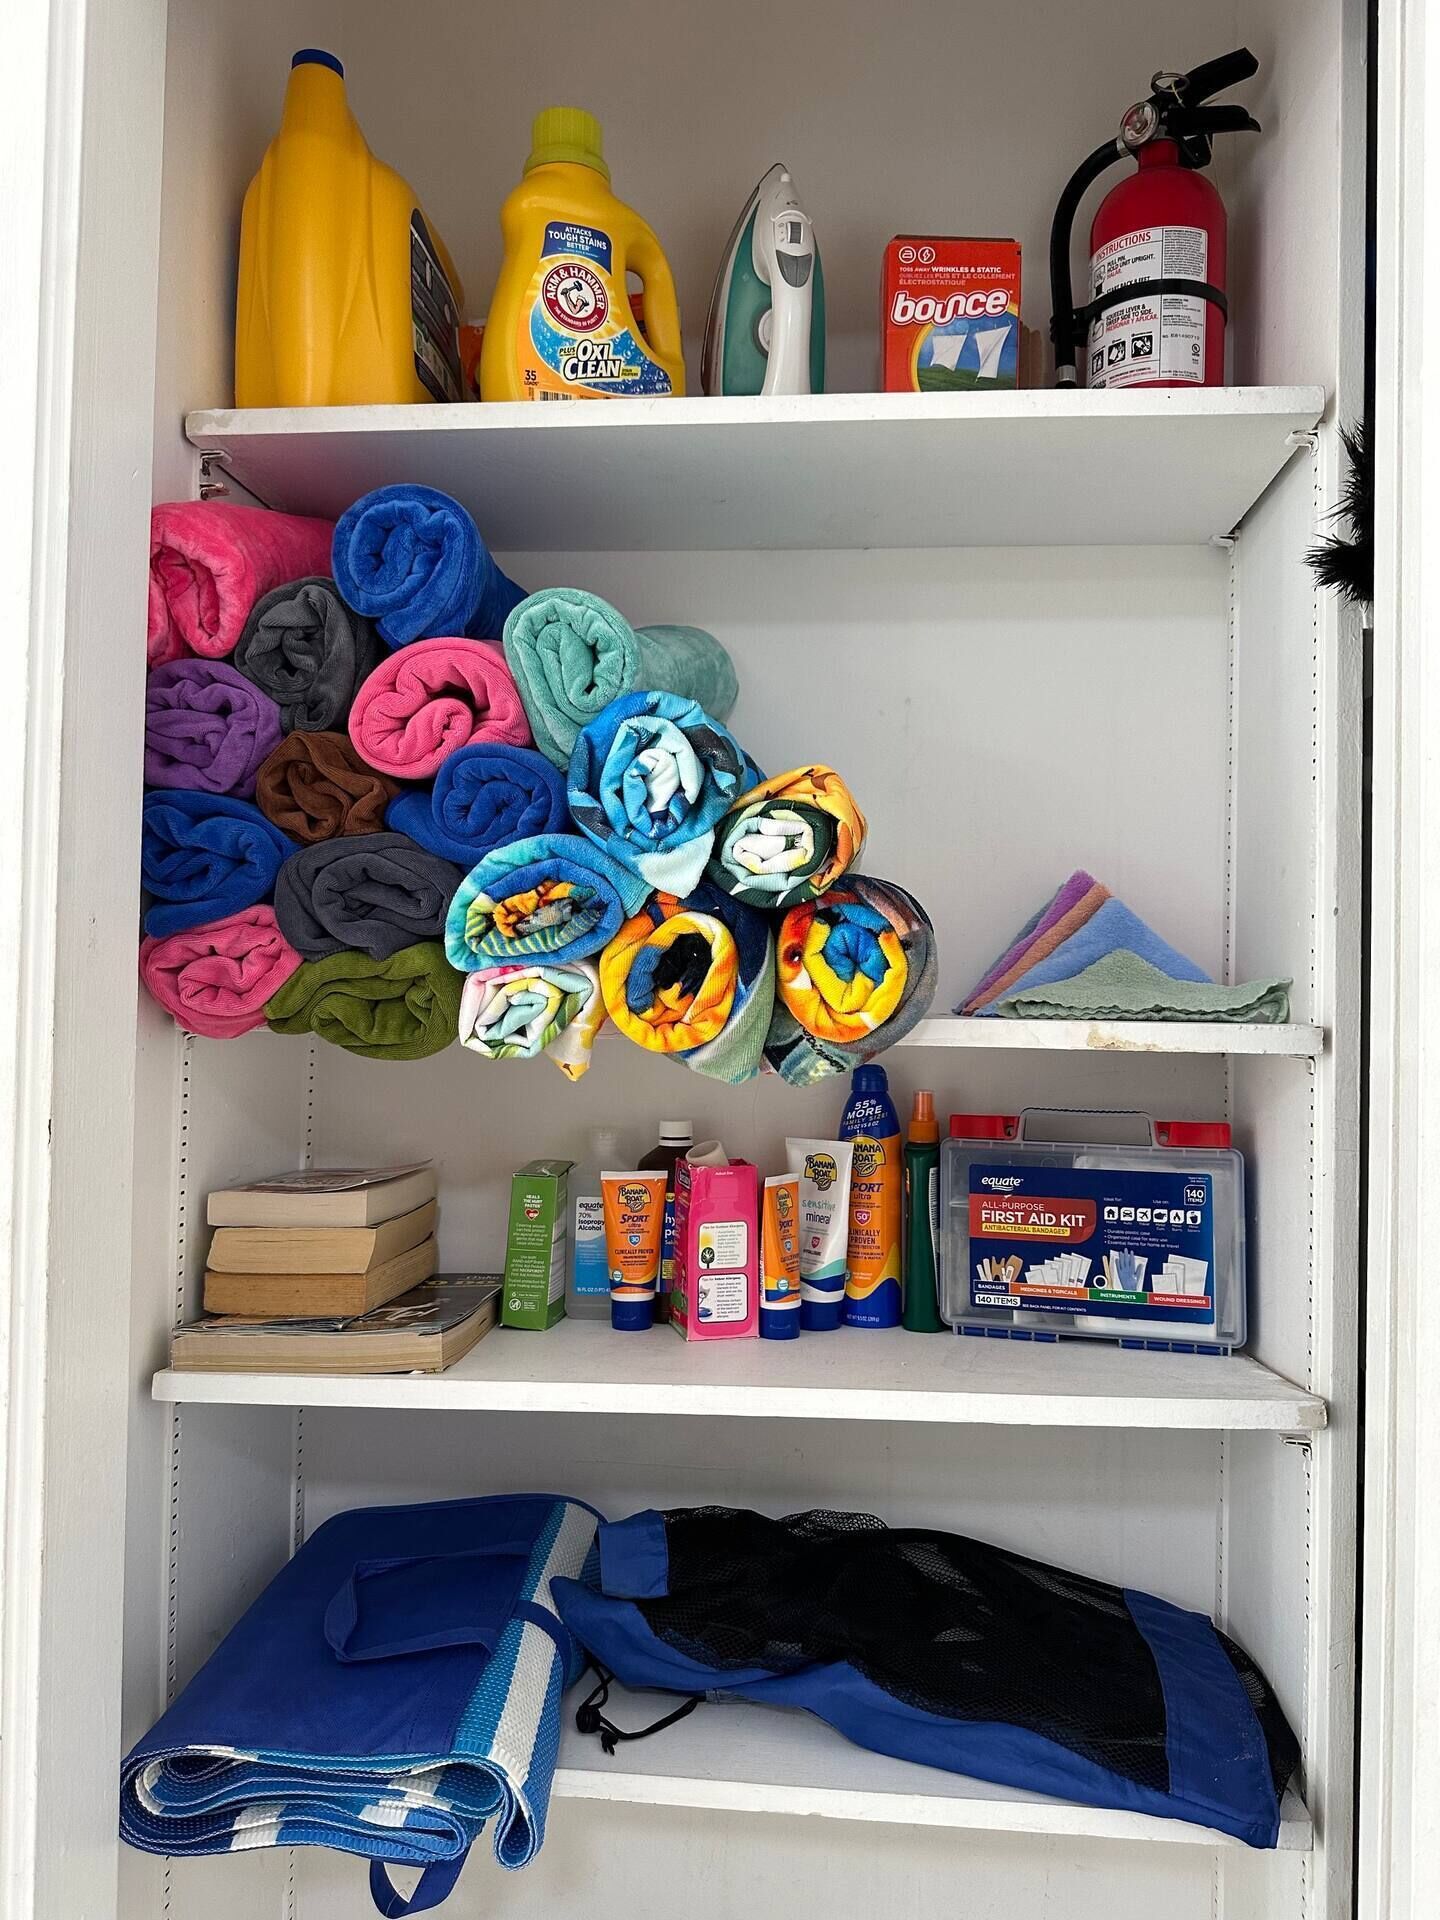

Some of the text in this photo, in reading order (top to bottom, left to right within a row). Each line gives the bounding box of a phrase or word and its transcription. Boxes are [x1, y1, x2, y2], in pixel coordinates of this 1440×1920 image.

[565, 226, 592, 237] ATTACKS
[548, 230, 607, 250] TOUGH STAINS
[1096, 232, 1151, 263] INSTRUCTIONS
[1120, 259, 1131, 268] UNIT
[547, 267, 604, 309] ARM & HAMMER
[891, 289, 1010, 326] bounce
[1125, 305, 1139, 314] LEVER
[559, 339, 610, 361] PLUS OXI
[563, 357, 621, 380] CLEAN
[525, 369, 537, 381] 35
[855, 1099, 876, 1110] 55%
[847, 1105, 882, 1120] MORE
[853, 1144, 881, 1153] ANANA
[808, 1158, 835, 1169] BANANA
[852, 1153, 875, 1166] BOAT
[812, 1168, 832, 1180] BOAT
[850, 1182, 884, 1192] PORT
[981, 1176, 1021, 1187] equate
[620, 1187, 647, 1196] BANANA
[1186, 1189, 1204, 1198] 140
[625, 1195, 644, 1204] BOAT
[579, 1202, 604, 1210] equate
[802, 1199, 836, 1212] sensitive
[982, 1201, 1045, 1211] ALL-PURPOSE
[619, 1214, 650, 1224] SPORT
[806, 1212, 831, 1225] mineral
[981, 1210, 1086, 1227] FIRST AID KIT
[851, 1236, 875, 1244] PROVEN
[994, 1297, 1018, 1306] ITEMS
